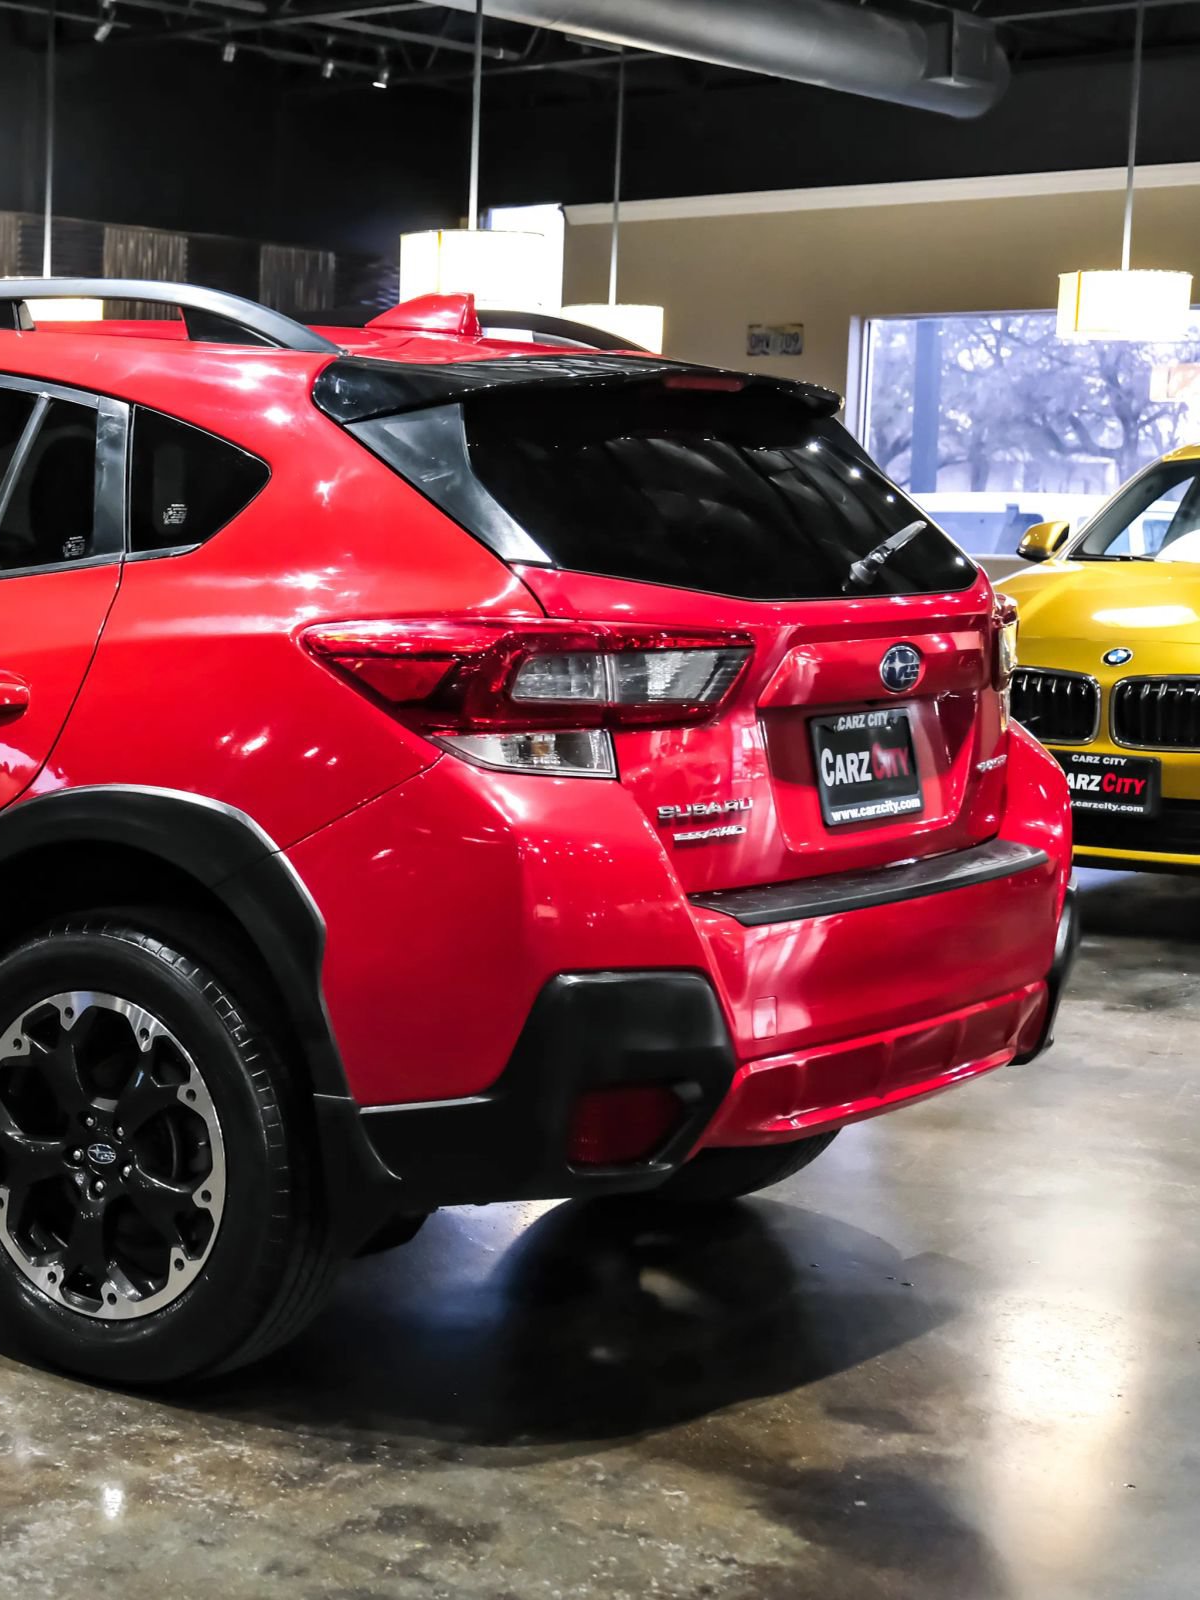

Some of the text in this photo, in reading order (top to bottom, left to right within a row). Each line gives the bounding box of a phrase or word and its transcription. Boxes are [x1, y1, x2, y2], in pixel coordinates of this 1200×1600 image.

[837, 712, 889, 731] CARZ CITY
[820, 748, 872, 787] CARZ
[1071, 754, 1127, 766] CARZ CITY
[1066, 772, 1146, 796] ARZ CITY
[657, 797, 754, 819] SUBARU
[831, 798, 921, 821] www.carzcity.com
[1070, 800, 1144, 813] .carzcity.com
